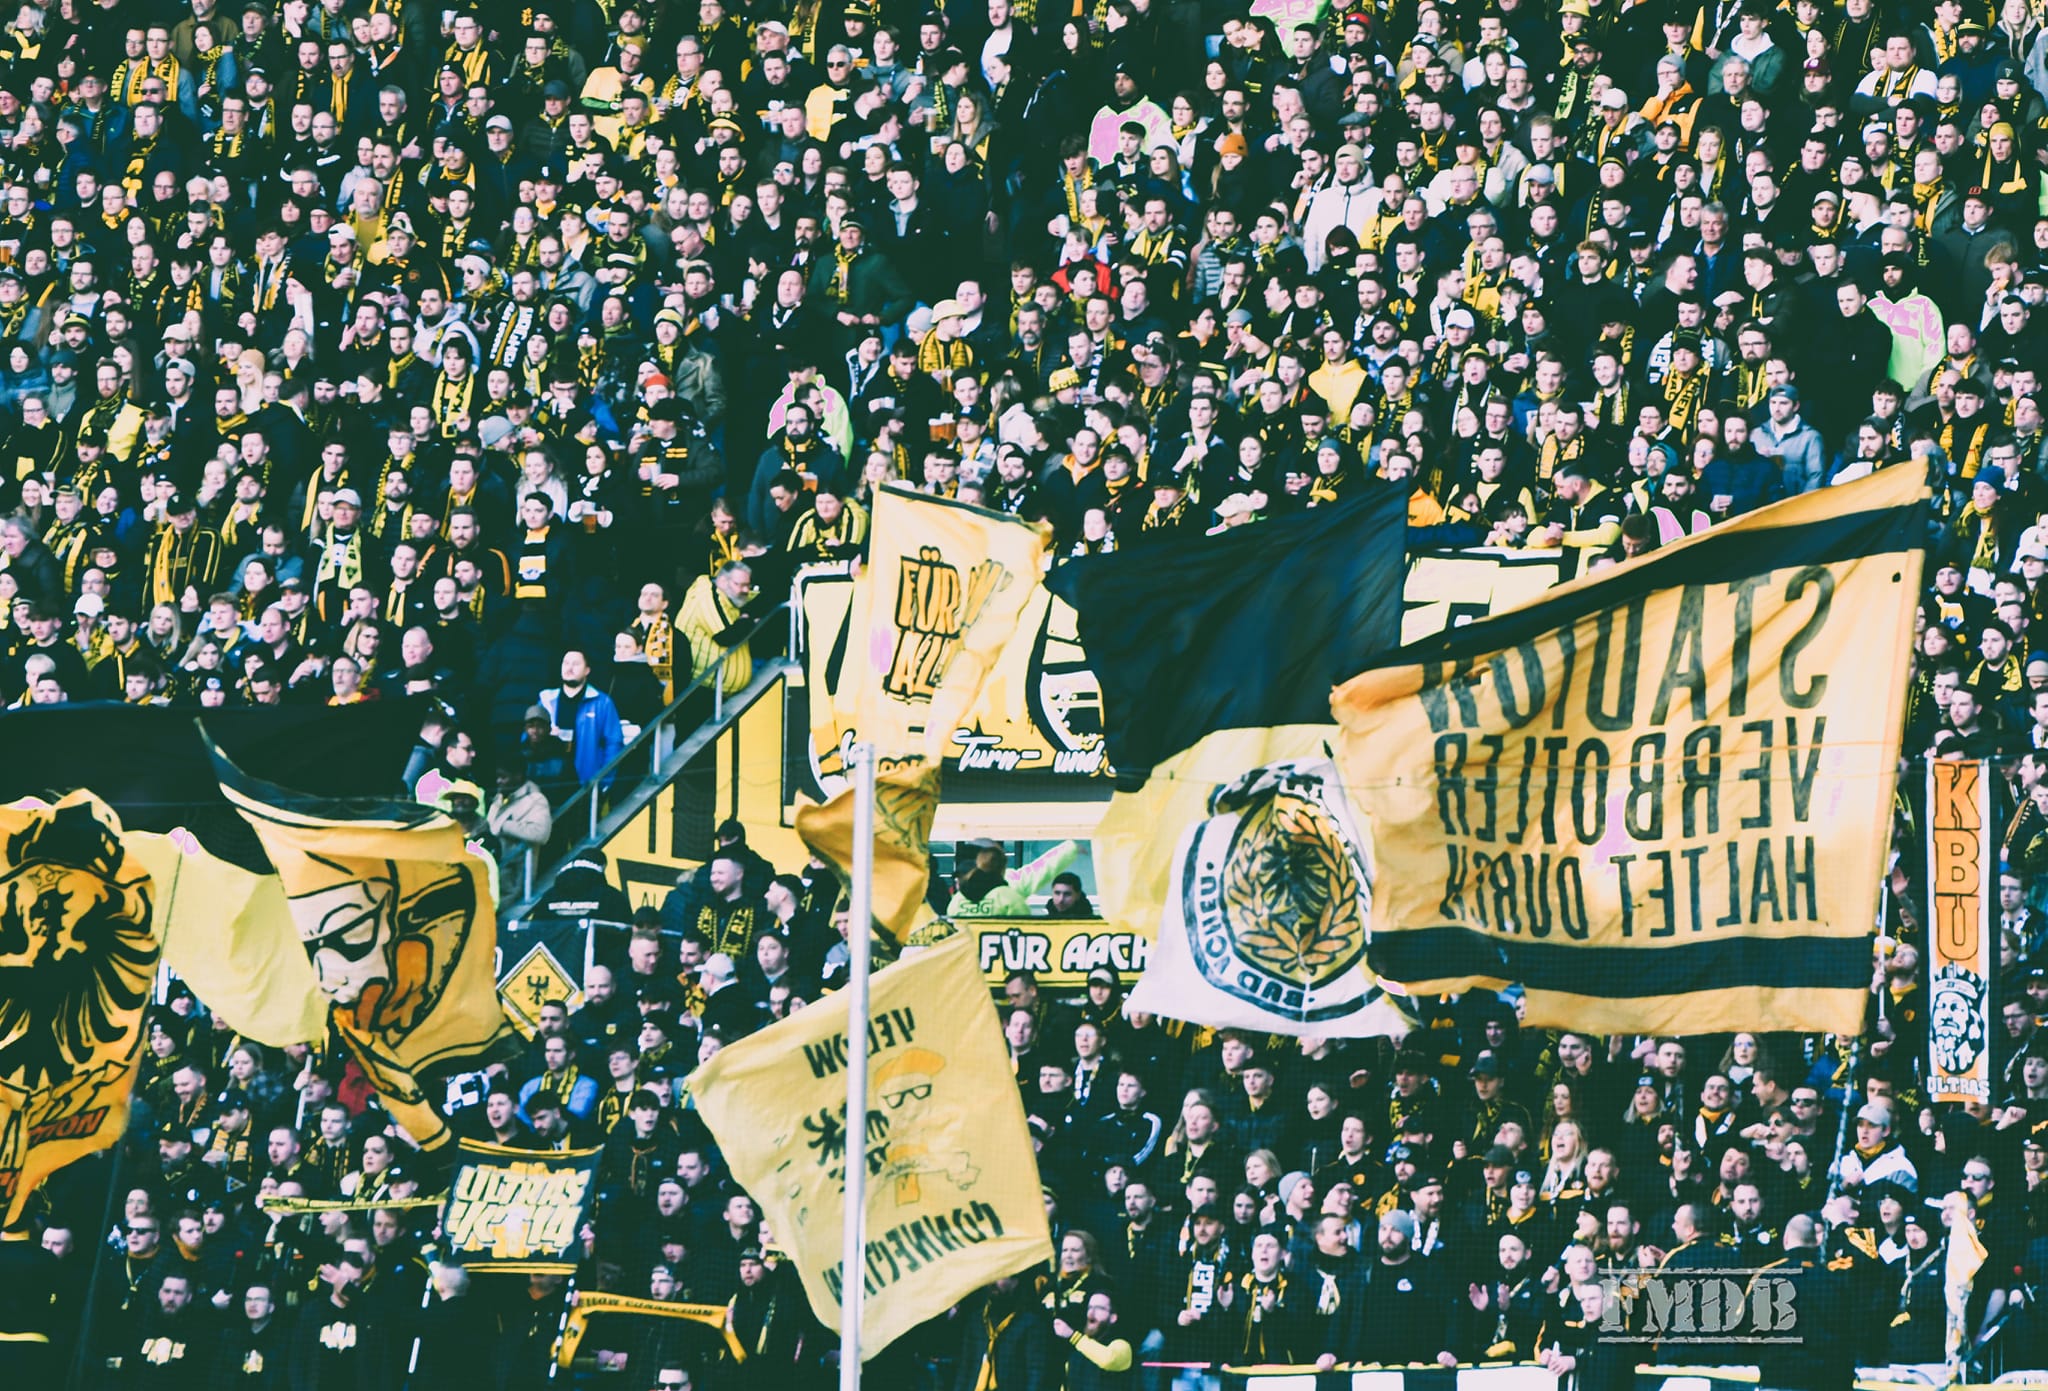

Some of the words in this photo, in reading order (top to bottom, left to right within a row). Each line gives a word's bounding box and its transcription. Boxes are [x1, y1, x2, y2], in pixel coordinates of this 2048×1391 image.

[895, 545, 960, 639] FÜR
[951, 728, 1042, 772] Turn-
[1053, 738, 1105, 773] und
[1933, 762, 1981, 961] KBU
[979, 928, 1051, 972] FÜR
[1927, 1075, 1990, 1097] ULTRAS
[453, 1164, 592, 1205] ULTRAS
